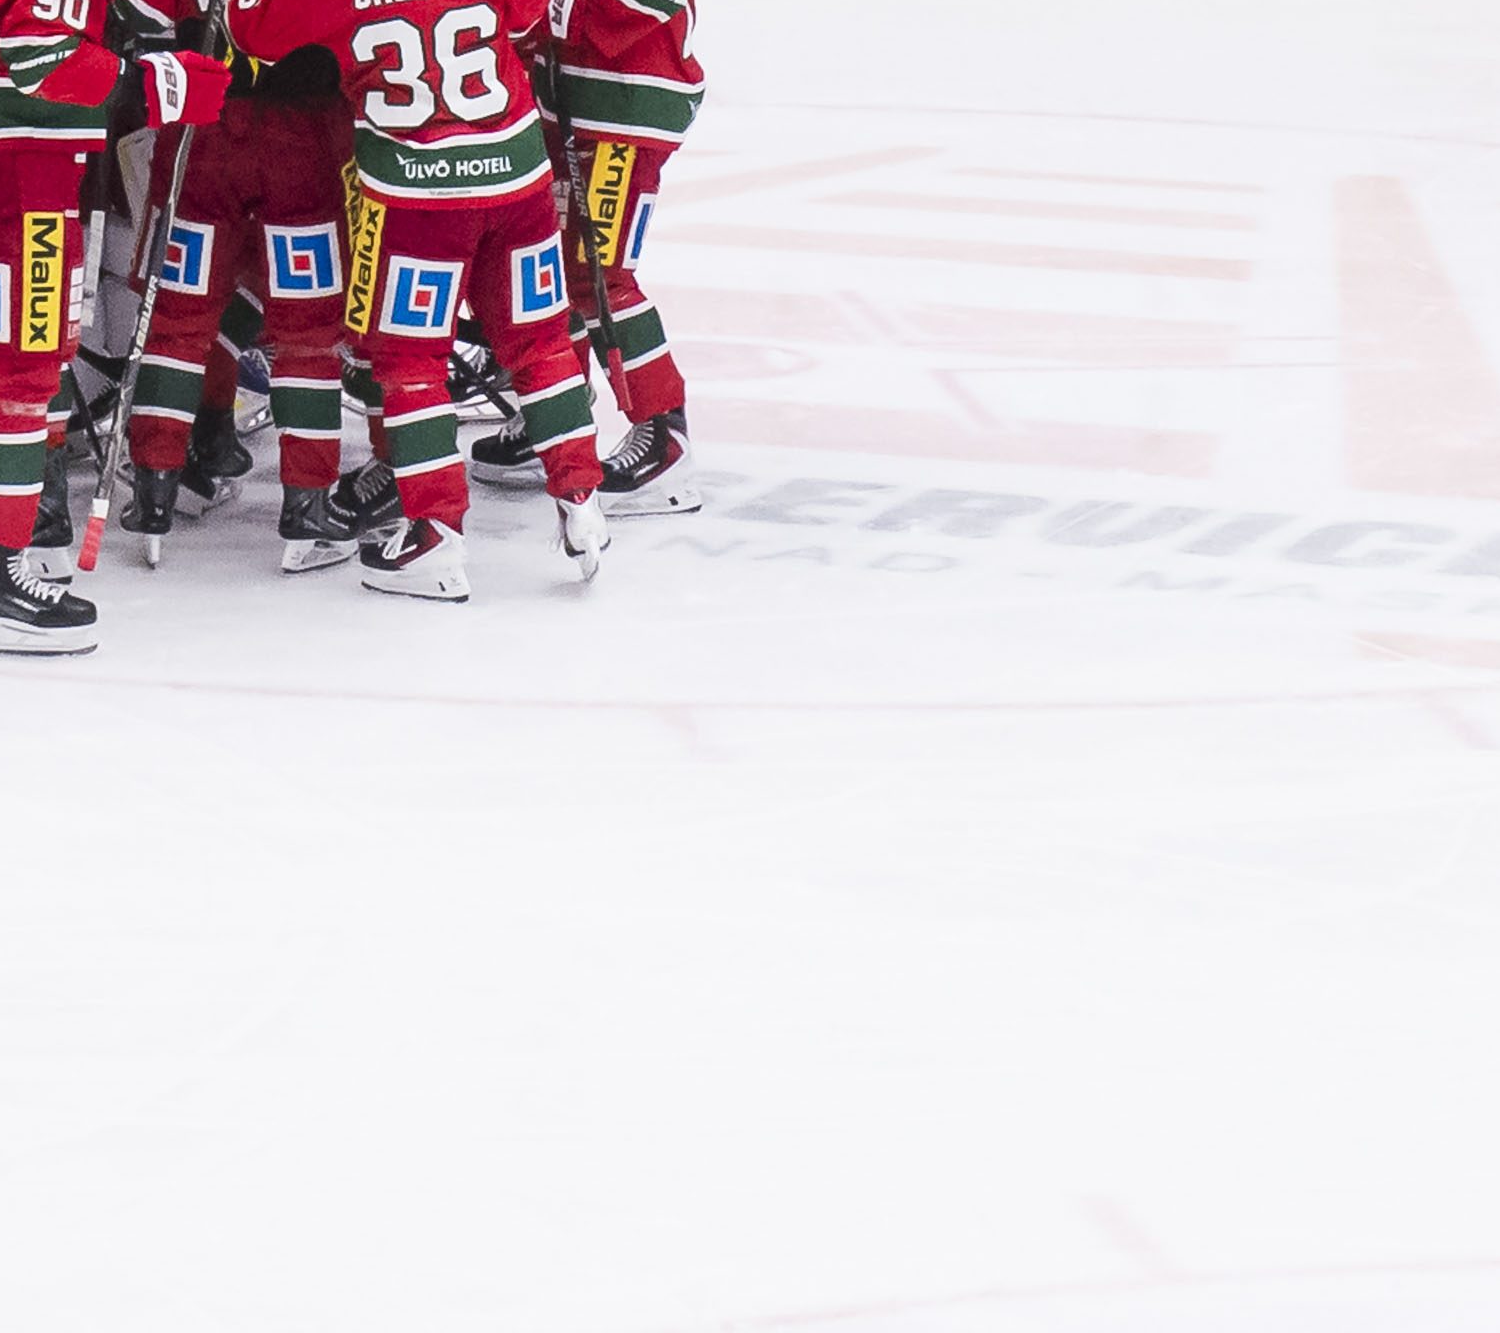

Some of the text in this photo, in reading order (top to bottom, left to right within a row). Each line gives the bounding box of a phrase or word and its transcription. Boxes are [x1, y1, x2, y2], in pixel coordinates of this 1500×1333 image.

[351, 2, 510, 129] 36
[404, 155, 513, 180] ULVÖ HOTELL
[25, 219, 55, 344] Malux
[347, 197, 381, 327] Malux
